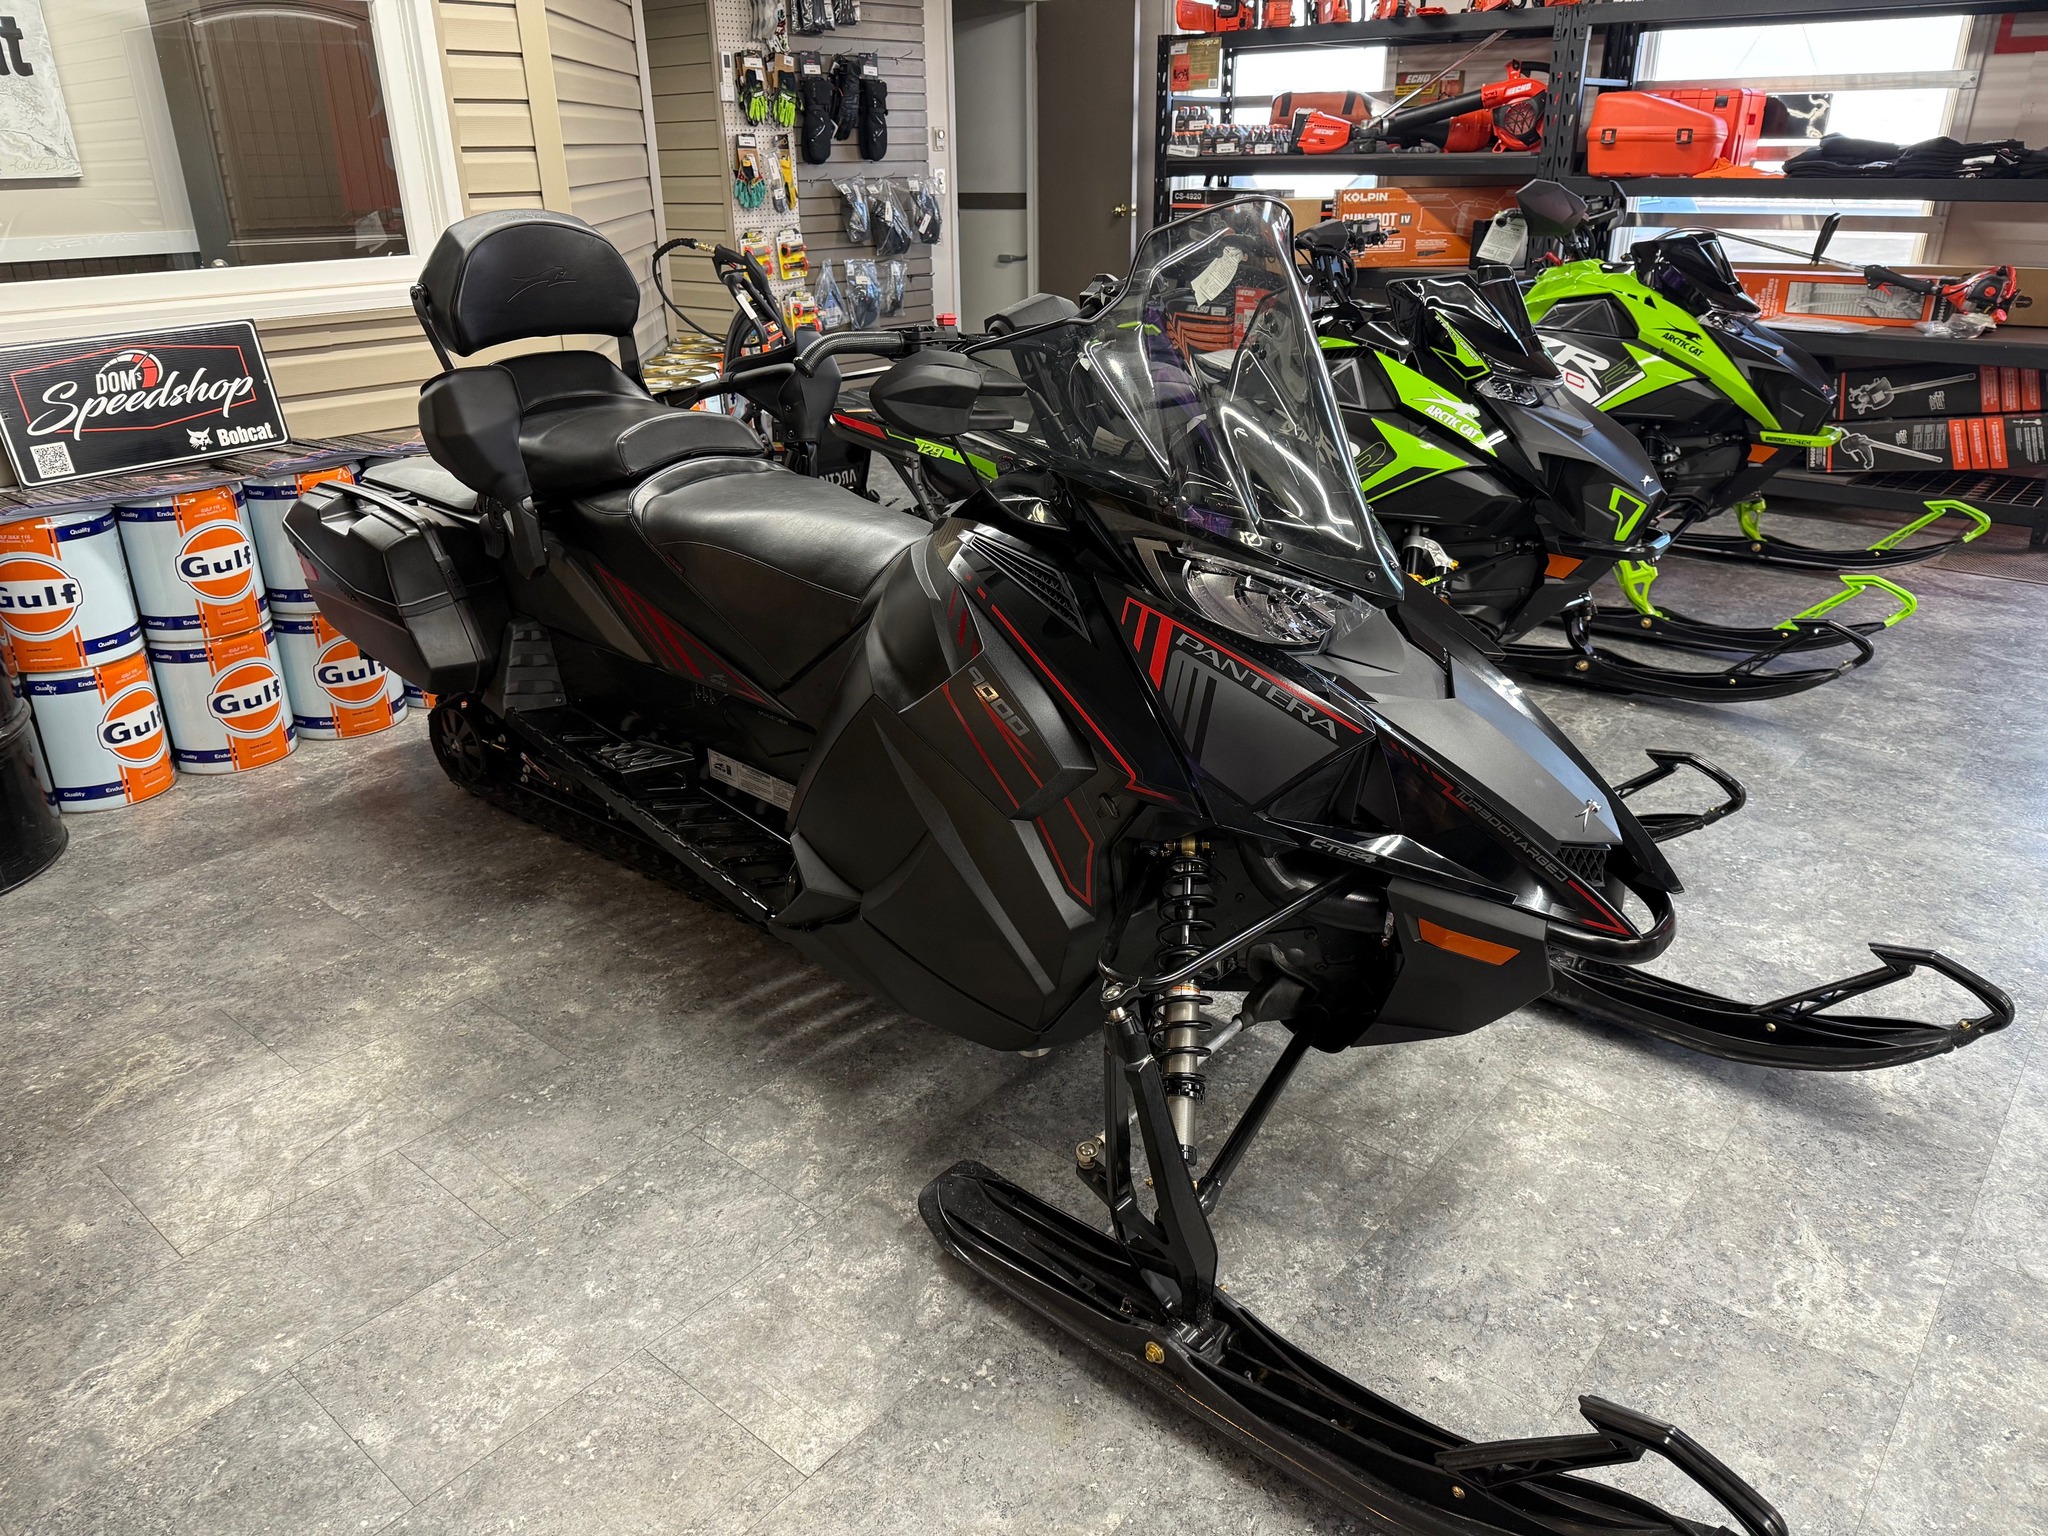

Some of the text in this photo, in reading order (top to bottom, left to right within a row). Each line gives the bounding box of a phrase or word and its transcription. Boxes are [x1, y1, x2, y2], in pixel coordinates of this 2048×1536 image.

[1405, 74, 1431, 84] ECHO
[1507, 83, 1532, 96] ECHO
[1174, 192, 1202, 200] CS-4920
[1343, 192, 1388, 202] KOLPIN
[1400, 214, 1410, 224] IV
[1661, 332, 1705, 358] ARCTIC CAT
[27, 367, 254, 442] Speedshop
[216, 422, 275, 447] Bobcat
[1424, 404, 1481, 440] ARCTIC CAT
[917, 442, 944, 458] 129
[70, 526, 91, 536] Quality
[180, 546, 251, 578] Gulf
[98, 638, 118, 648] Quality
[318, 658, 386, 685] Gulf
[35, 684, 57, 693] Quality
[212, 678, 281, 714] Gulf
[1176, 633, 1338, 740] PANTERA
[968, 666, 1030, 737] 9000
[102, 704, 163, 744] Gulf
[1454, 787, 1570, 882] TURBOCHARGED
